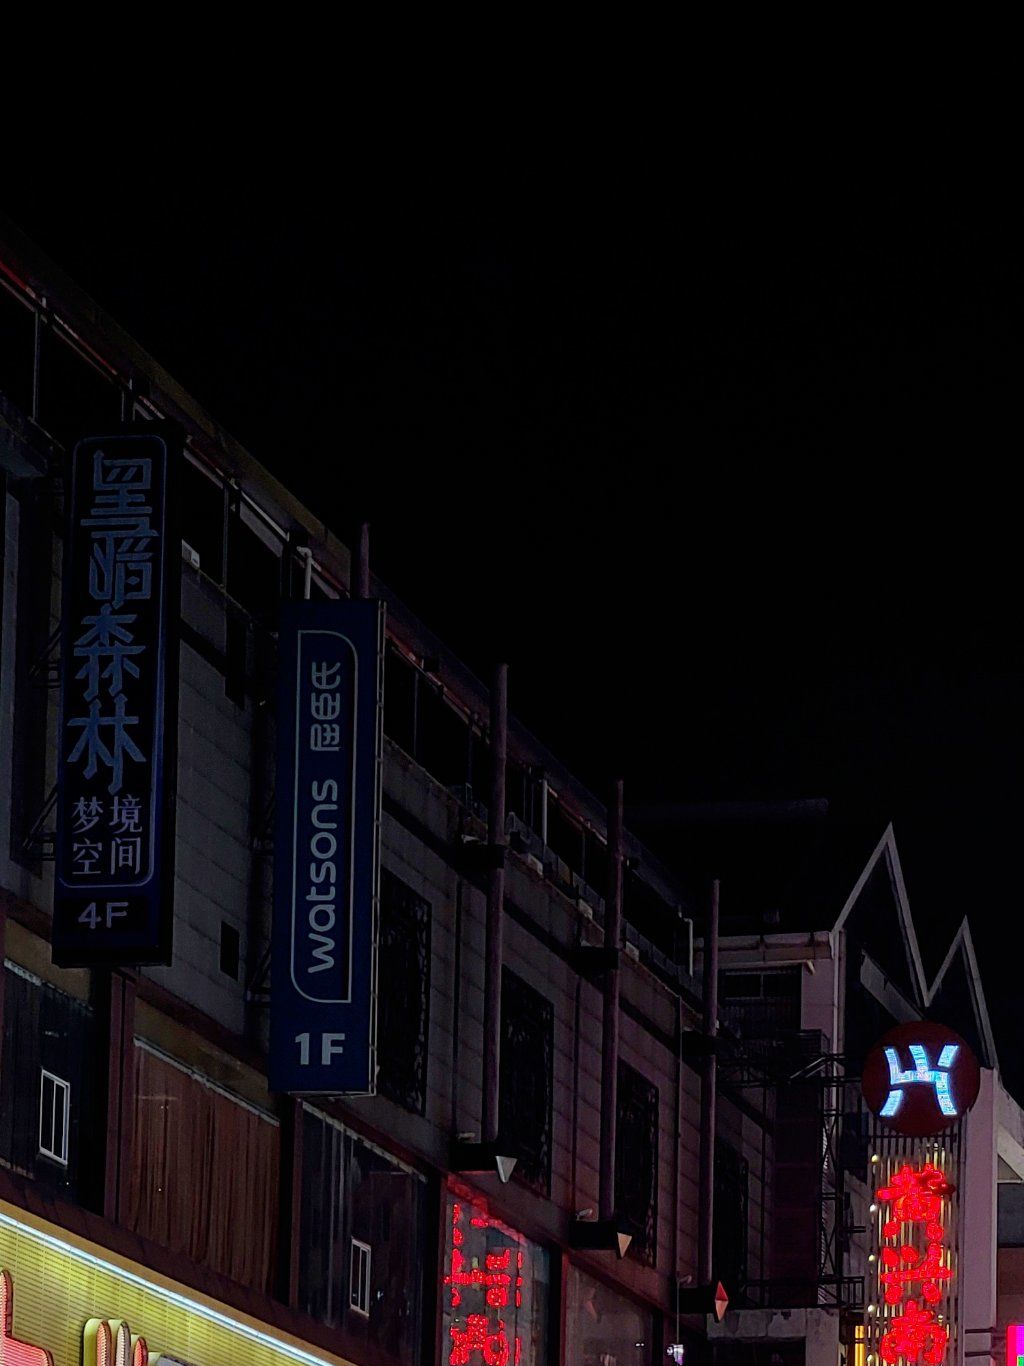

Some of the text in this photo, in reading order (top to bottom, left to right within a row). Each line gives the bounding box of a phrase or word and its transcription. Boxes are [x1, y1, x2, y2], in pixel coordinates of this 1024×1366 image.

[310, 660, 342, 752] 屈臣氏
[71, 796, 142, 834] 梦境
[72, 838, 141, 876] 空间
[306, 778, 339, 973] watsons
[78, 901, 129, 930] 4F
[295, 1033, 346, 1066] 1F
